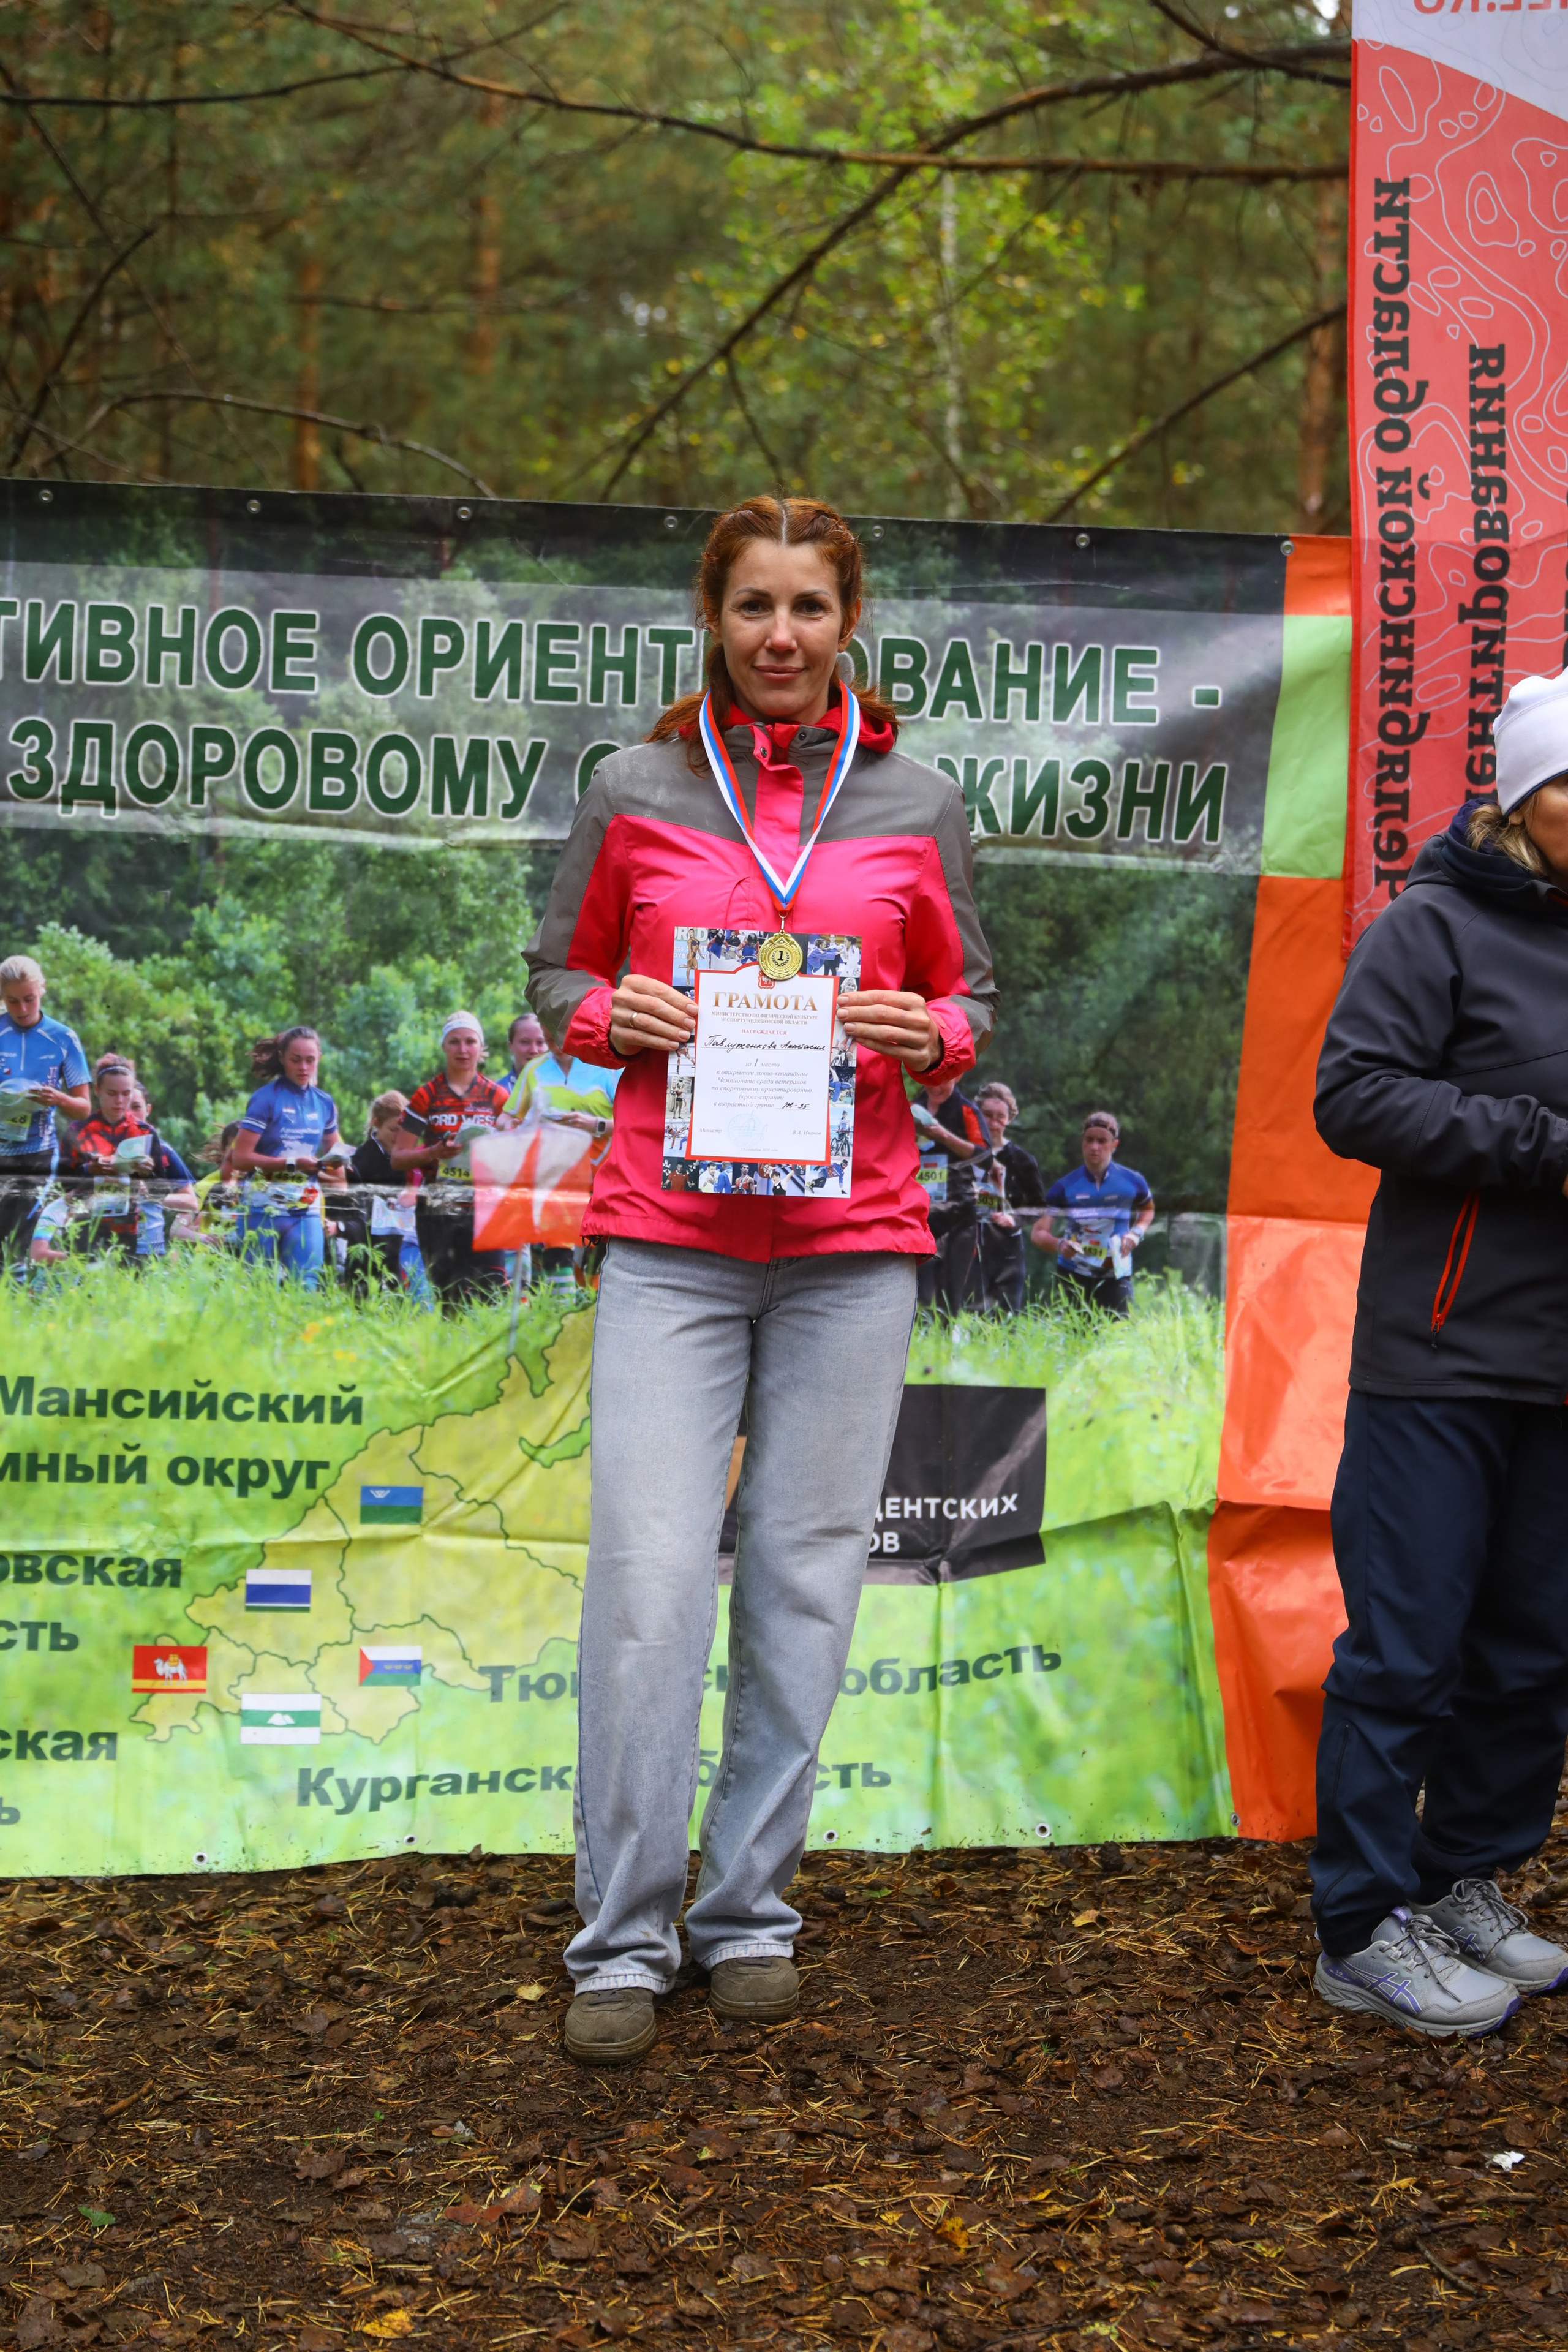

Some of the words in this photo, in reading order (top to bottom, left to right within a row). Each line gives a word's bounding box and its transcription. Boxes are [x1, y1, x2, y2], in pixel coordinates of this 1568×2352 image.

[7, 717, 549, 821] ЗДОРОВОМУ
[777, 950, 784, 962] 1
[712, 991, 818, 1012] ГРАМОТА
[918, 1170, 943, 1182] 4501
[0, 1376, 363, 1426] Мансийский
[167, 1455, 330, 1498] округ
[839, 1644, 1062, 1696] область
